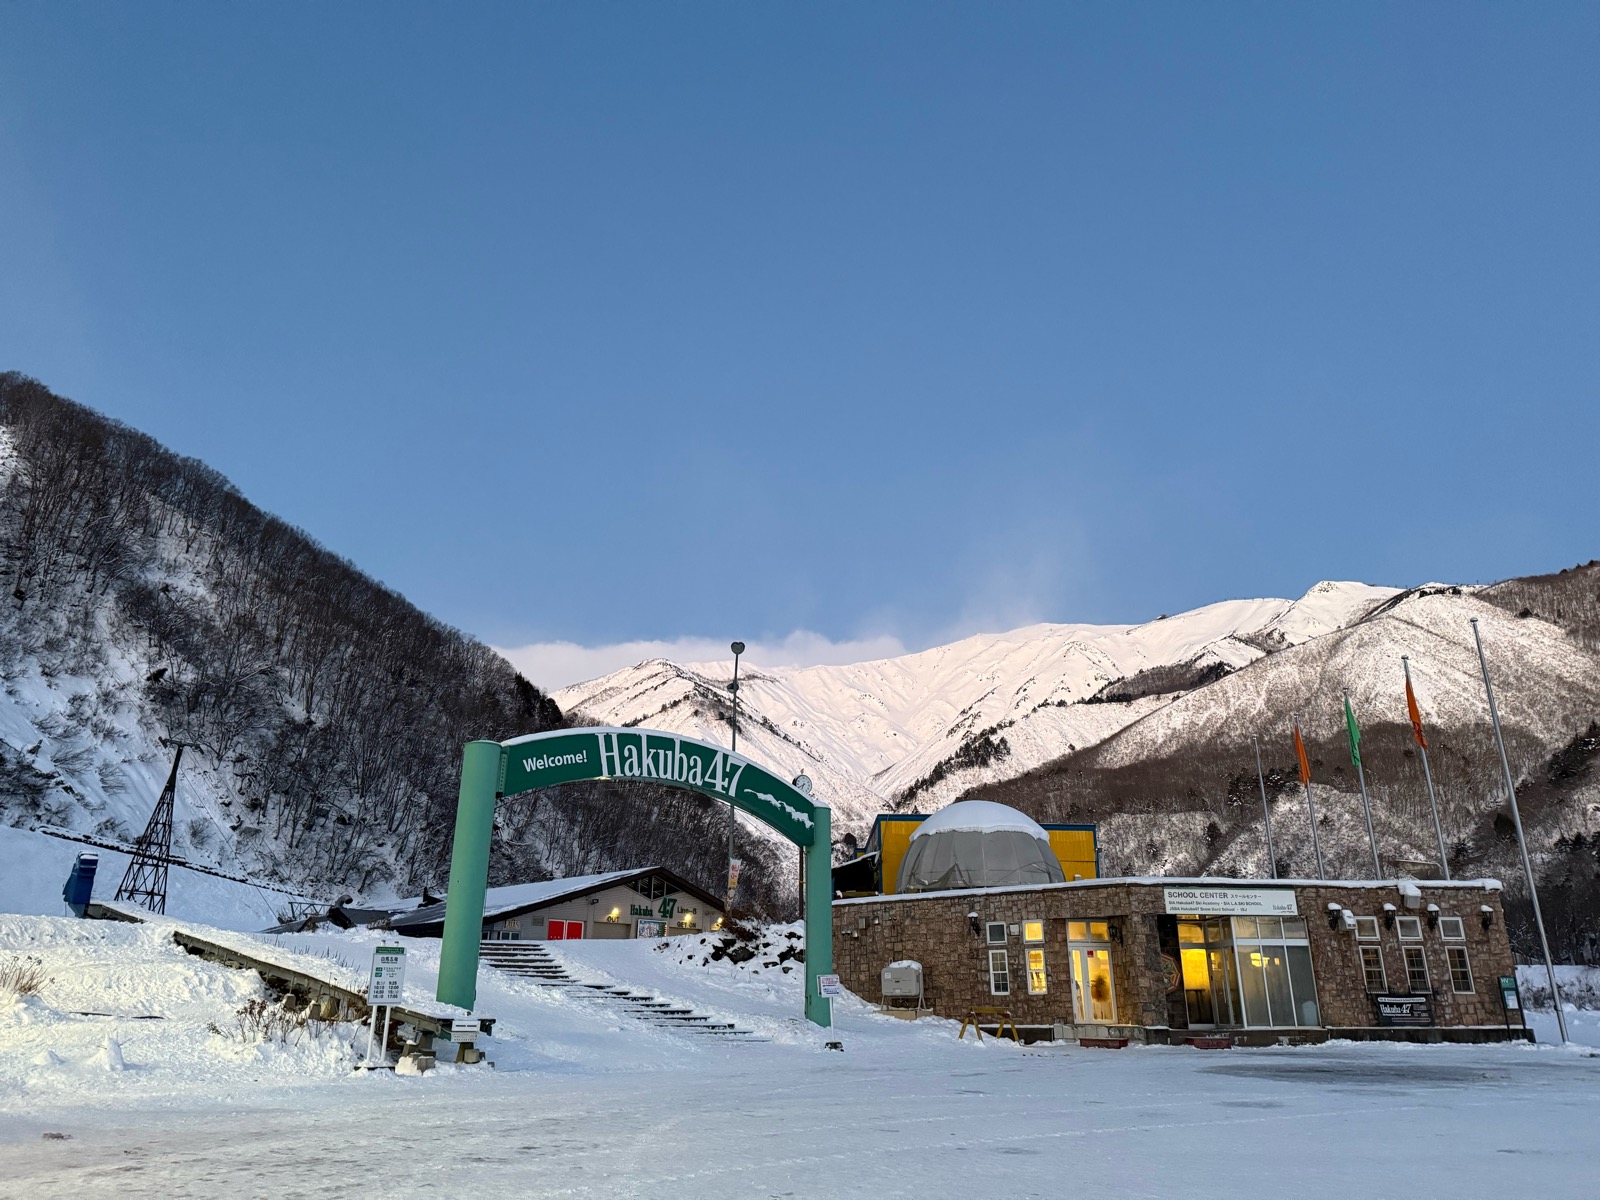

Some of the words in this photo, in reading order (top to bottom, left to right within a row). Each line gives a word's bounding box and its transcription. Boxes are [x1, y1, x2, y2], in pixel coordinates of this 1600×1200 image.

[523, 750, 587, 772] Welcome!
[630, 904, 653, 917] Hakuba
[658, 897, 677, 919] 47
